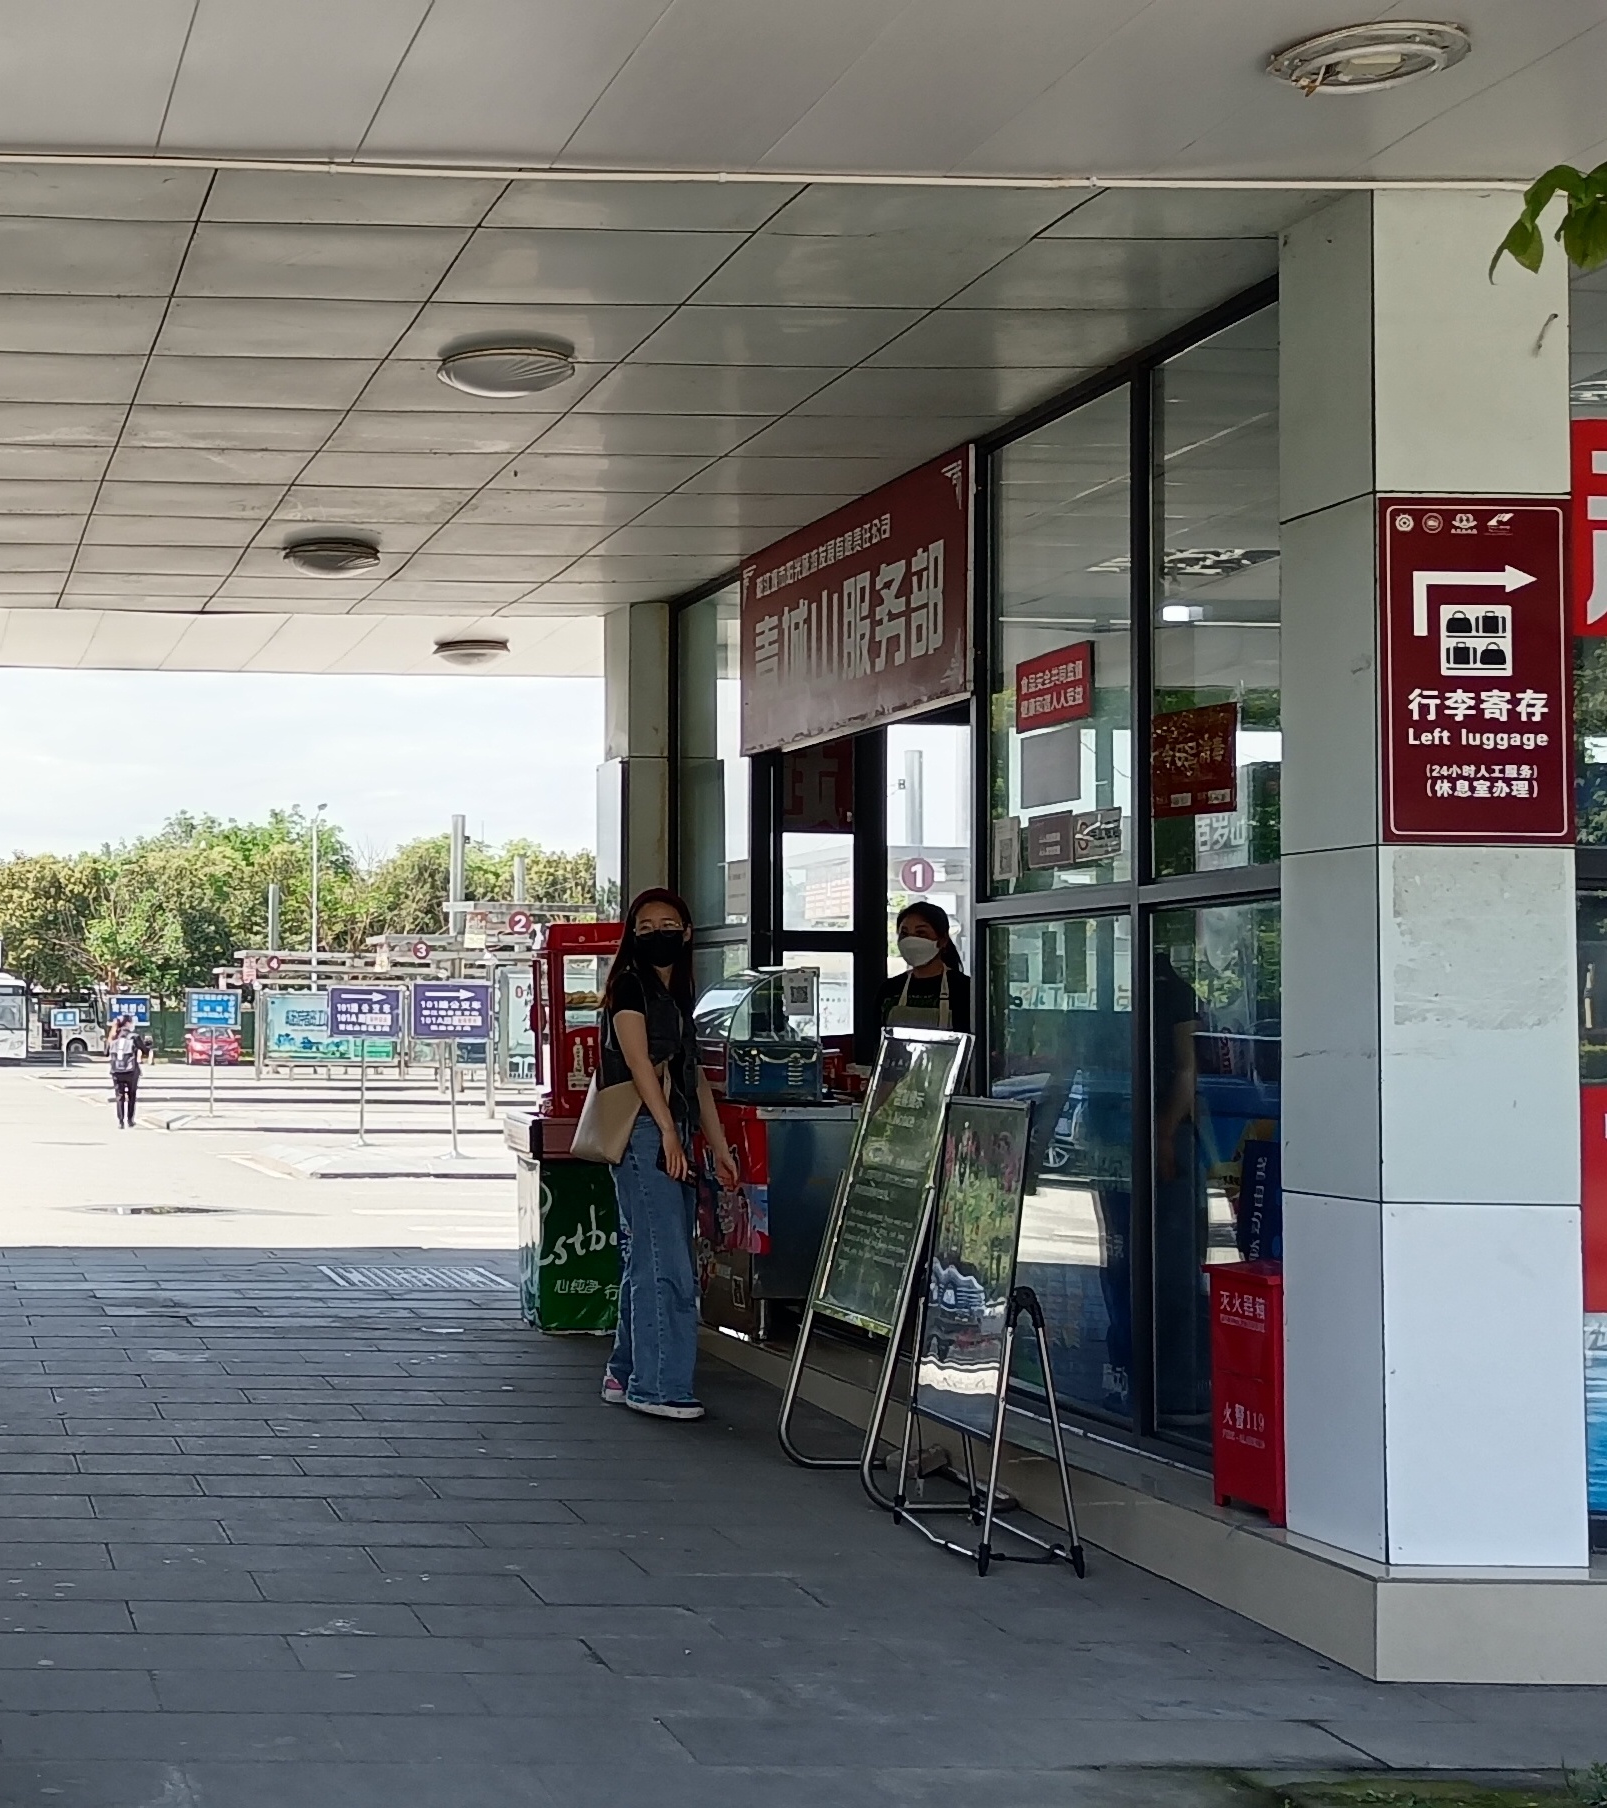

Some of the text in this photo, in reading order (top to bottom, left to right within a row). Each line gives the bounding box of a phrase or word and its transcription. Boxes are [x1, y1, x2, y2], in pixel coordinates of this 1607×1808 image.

[1408, 688, 1549, 722] 行李寄存
[1408, 728, 1549, 750] Left luggage
[910, 863, 923, 888] 1
[514, 914, 527, 932] 2
[416, 944, 426, 957] 3
[269, 957, 279, 969] 4
